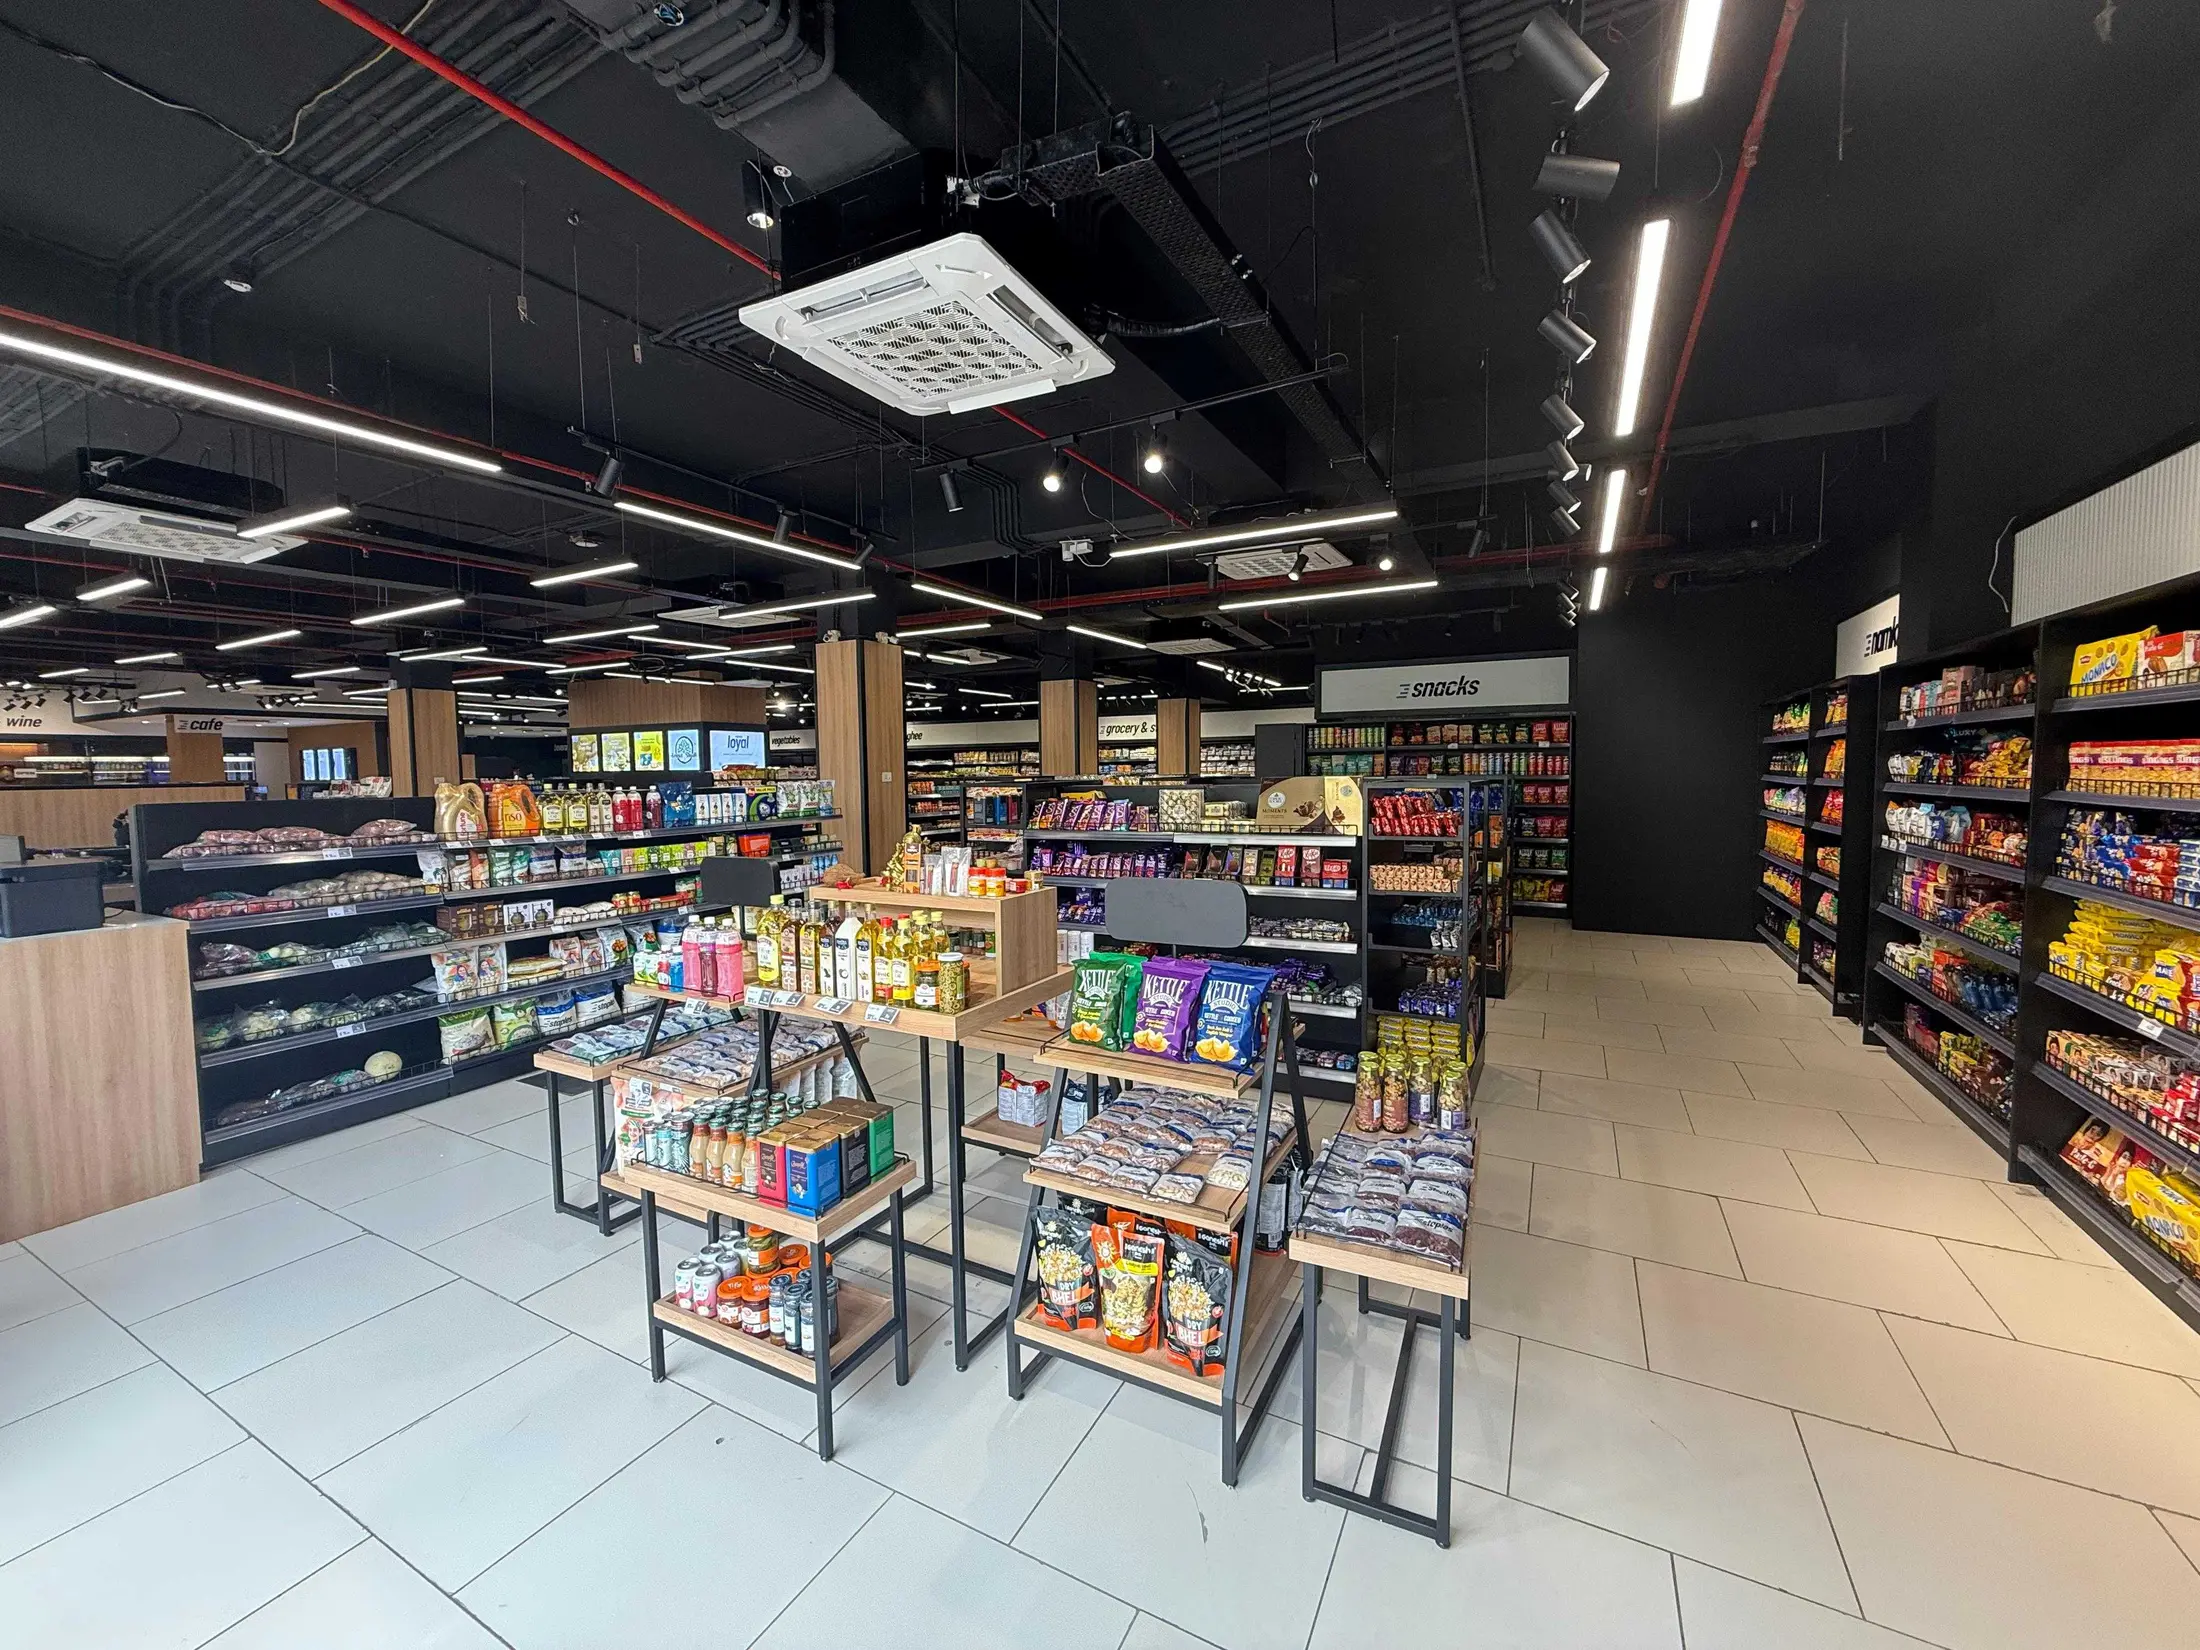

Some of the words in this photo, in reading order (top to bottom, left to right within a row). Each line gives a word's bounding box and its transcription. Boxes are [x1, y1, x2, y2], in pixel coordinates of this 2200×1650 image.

[2082, 654, 2117, 682] MONACO
[1411, 675, 1480, 698] snacks
[6, 714, 43, 728] wine
[190, 718, 223, 731] cafe
[1106, 724, 1140, 737] grocery
[1140, 721, 1149, 733] &
[727, 735, 749, 752] loyal
[771, 735, 801, 747] vegetables
[1078, 969, 1116, 994] KETTLE
[1143, 974, 1190, 1004] KETTLE
[1203, 980, 1254, 1010] KETTLE
[549, 1016, 573, 1027] staples
[2145, 1214, 2185, 1241] MONACO
[1060, 1281, 1075, 1291] DRY
[1186, 1319, 1202, 1331] DRY
[1177, 1326, 1204, 1345] BHEL
